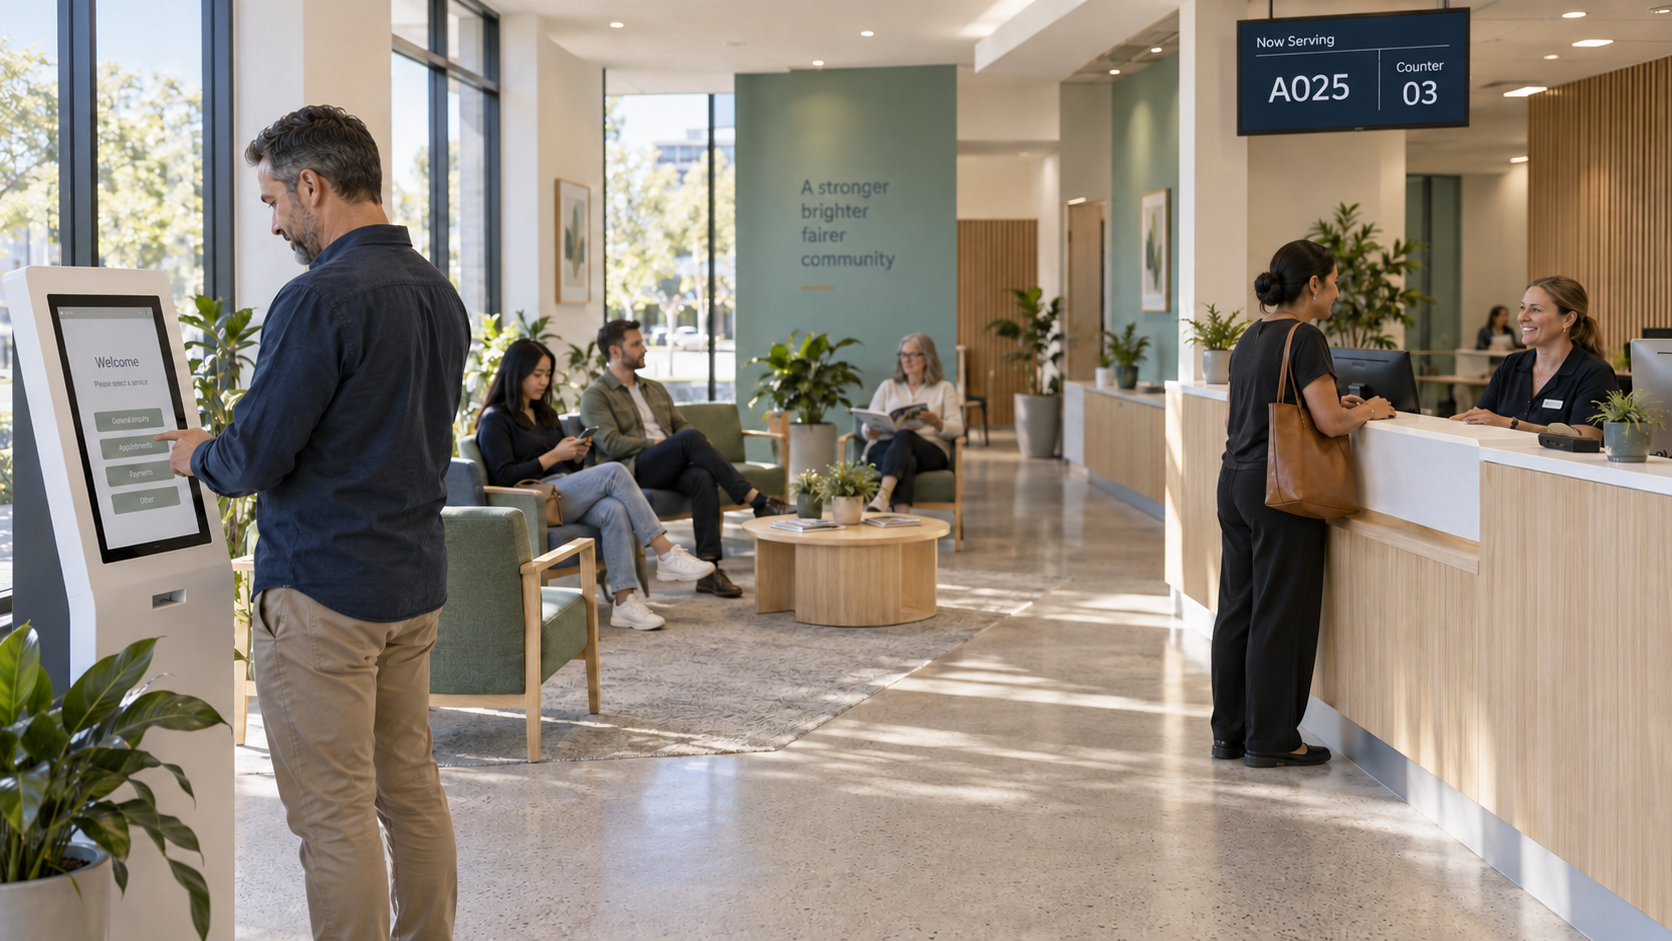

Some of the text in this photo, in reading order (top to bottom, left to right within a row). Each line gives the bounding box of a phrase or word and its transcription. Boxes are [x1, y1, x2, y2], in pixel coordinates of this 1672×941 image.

[1256, 34, 1335, 48] Now Serving
[1396, 61, 1444, 73] Counter
[1268, 73, 1350, 103] A025
[1402, 80, 1438, 106] 03
[801, 179, 890, 199] A stronger
[801, 203, 870, 223] brighter
[801, 226, 847, 243] fairer
[801, 250, 896, 271] community
[94, 356, 140, 369] Welcome
[94, 380, 111, 388] Please
[111, 416, 131, 425] General
[118, 442, 153, 452] Appointments
[129, 469, 154, 479] Payments
[140, 496, 155, 505] Other
